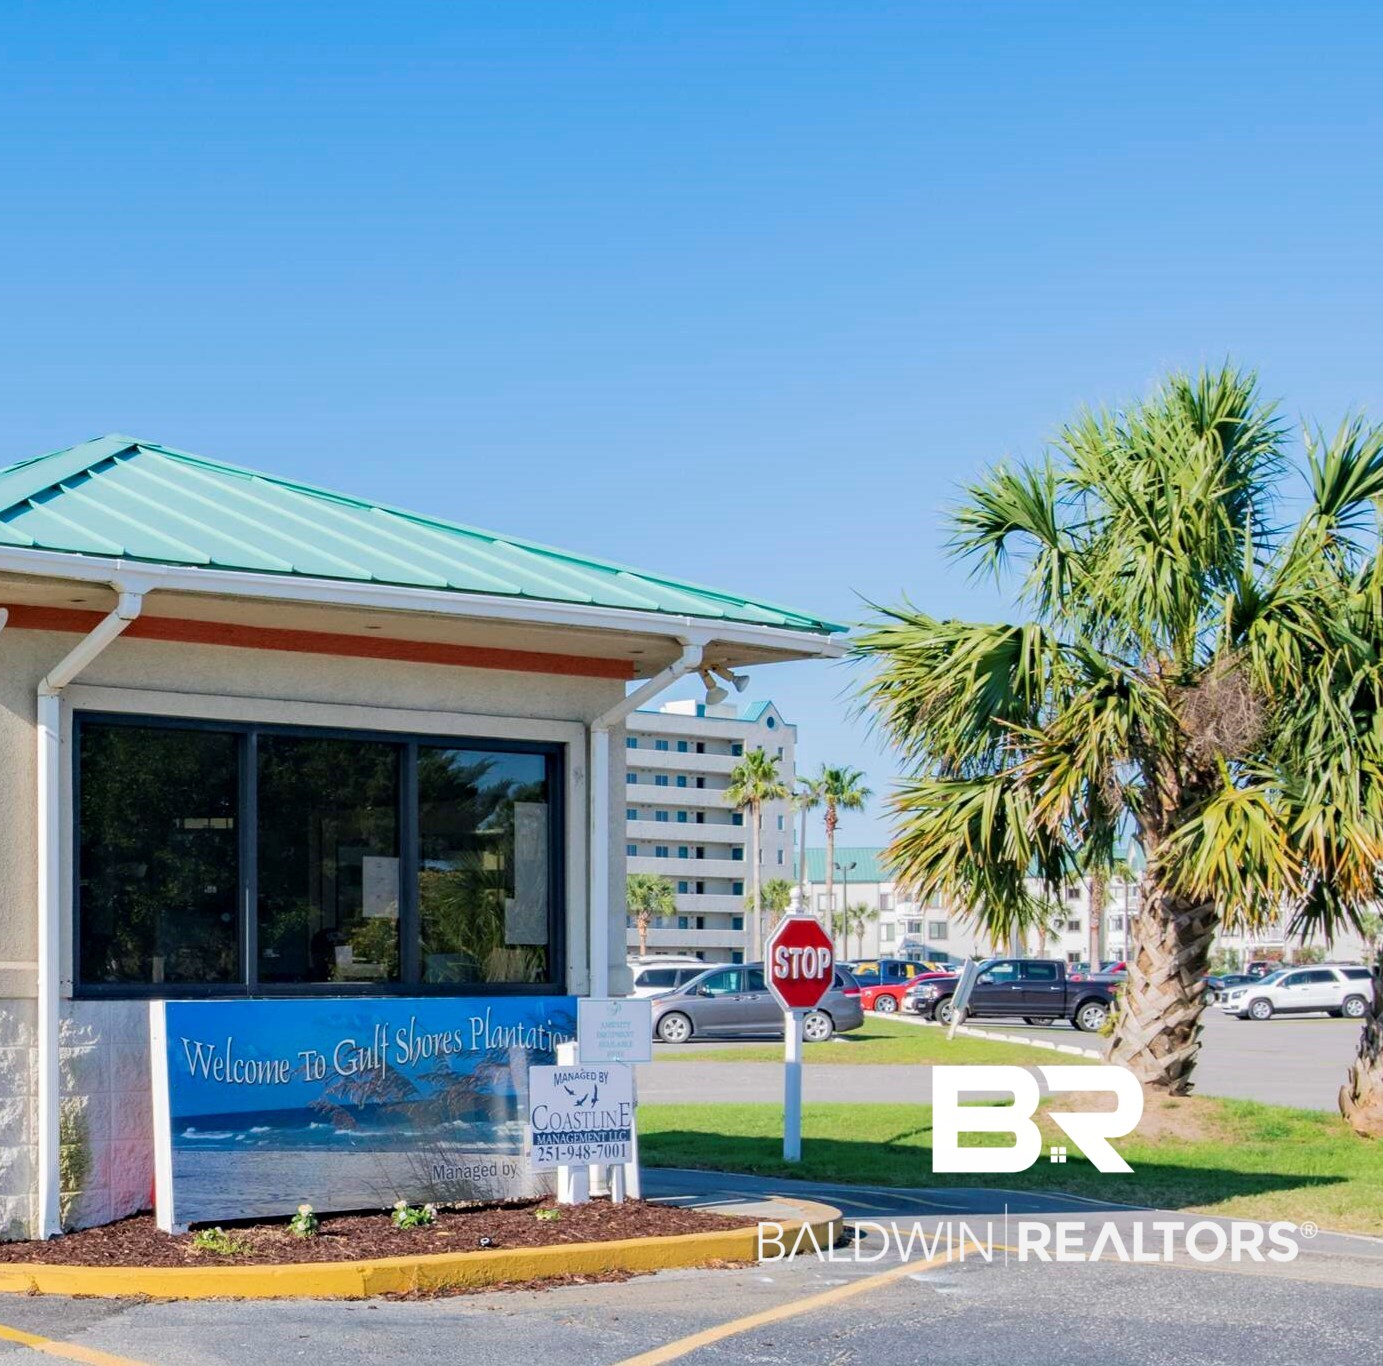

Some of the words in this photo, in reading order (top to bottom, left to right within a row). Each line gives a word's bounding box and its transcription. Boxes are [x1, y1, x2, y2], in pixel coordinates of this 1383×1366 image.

[774, 945, 831, 979] STOP
[180, 1036, 290, 1085] Welcome
[297, 1050, 326, 1082] To
[333, 1022, 389, 1080] Gulf
[396, 1016, 462, 1066] Shores
[553, 1072, 596, 1087] MANAGED
[599, 1071, 609, 1084] BY
[537, 1133, 606, 1145] MANAGEMENT
[609, 1131, 627, 1142] LLC
[538, 1144, 626, 1162] 251-948-7001
[432, 1162, 497, 1181] Managed
[502, 1162, 517, 1179] by
